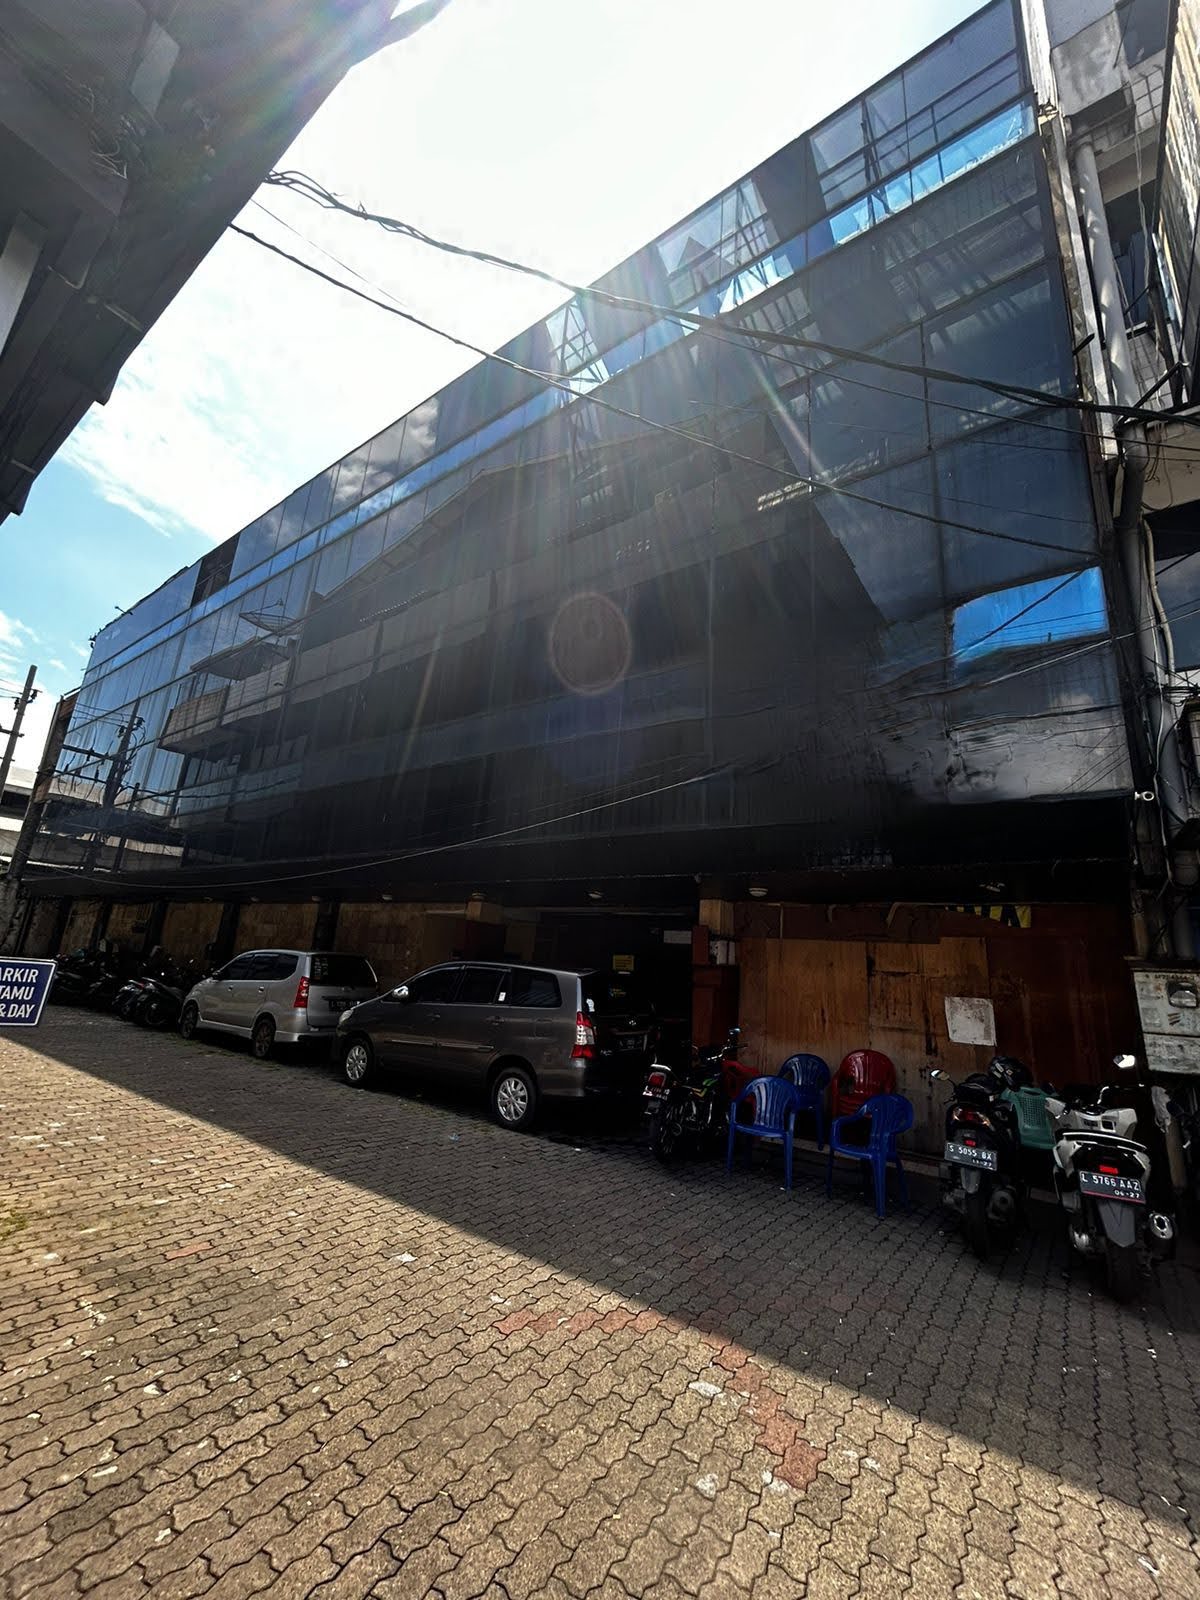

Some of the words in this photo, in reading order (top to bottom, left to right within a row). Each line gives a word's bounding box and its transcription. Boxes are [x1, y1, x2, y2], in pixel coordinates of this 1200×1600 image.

[0, 967, 39, 983] RKIR
[949, 1144, 954, 1152] S
[1081, 1173, 1088, 1182] L
[1092, 1175, 1117, 1187] 5766
[1119, 1180, 1139, 1191] AAZ
